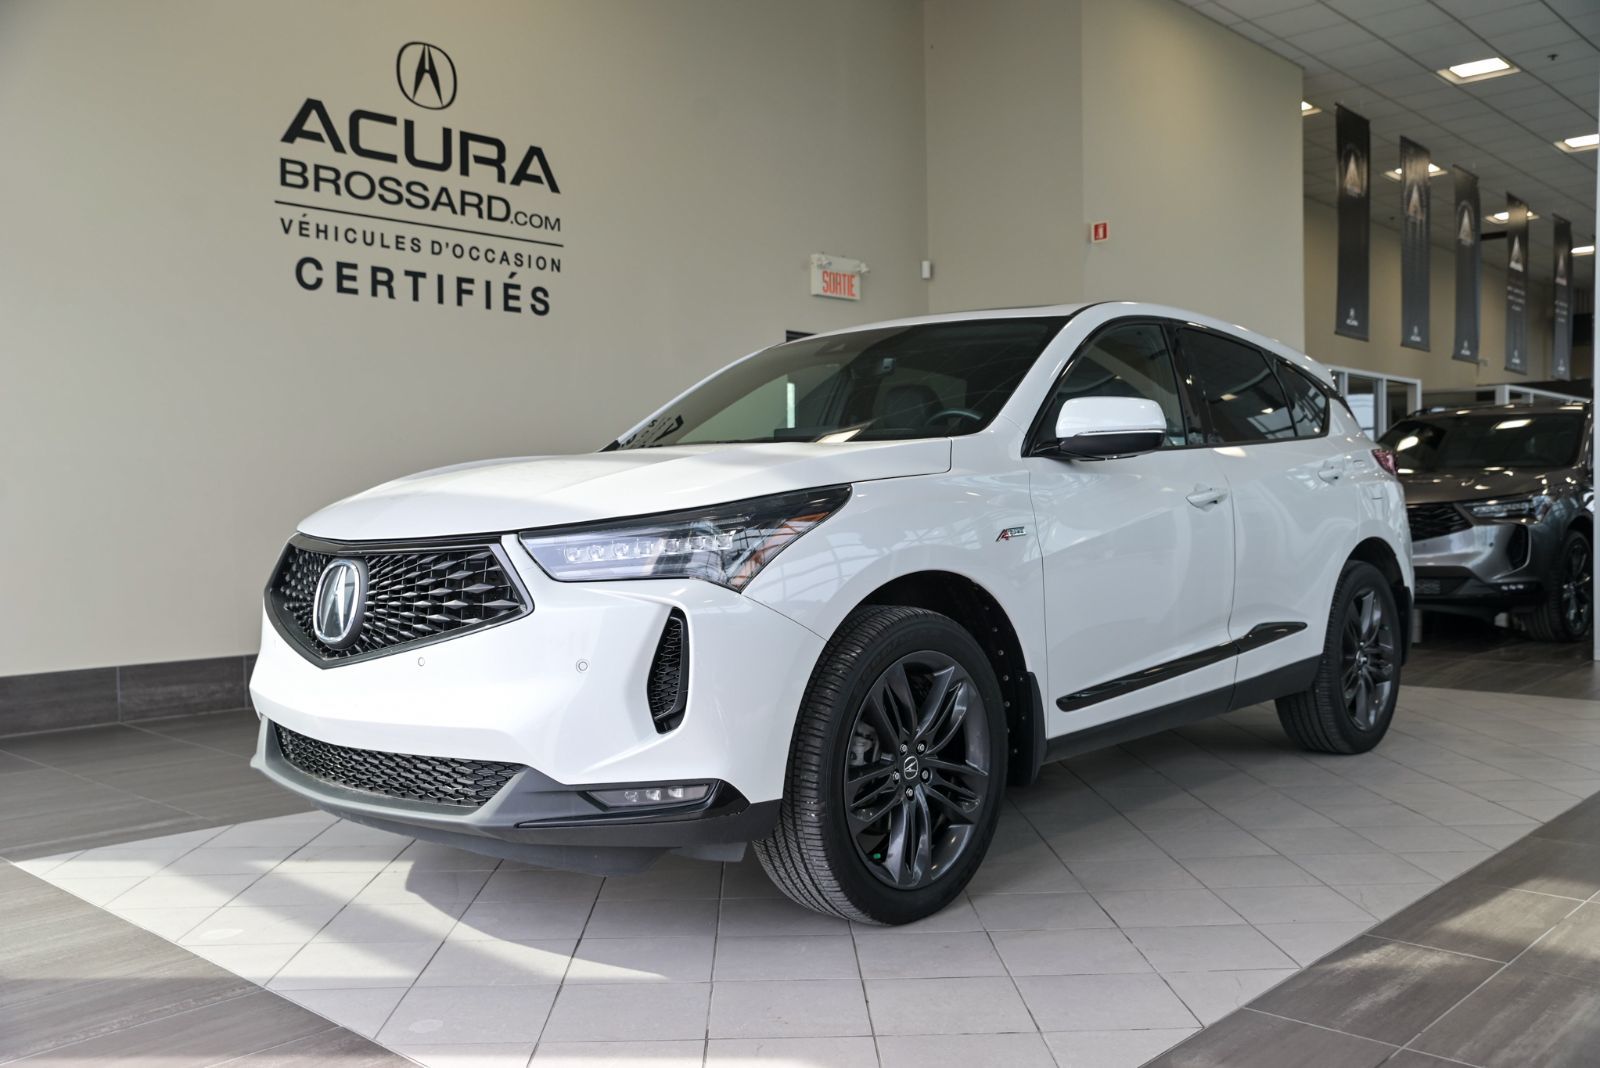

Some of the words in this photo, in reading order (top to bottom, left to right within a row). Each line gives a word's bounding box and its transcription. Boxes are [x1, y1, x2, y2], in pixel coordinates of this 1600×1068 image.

[279, 97, 561, 195] ACURA
[279, 157, 561, 232] BROSSARD.COM
[279, 213, 422, 254] VÉHICULES
[430, 239, 561, 273] D'OCCASION
[295, 256, 550, 317] CERTIFIÉS
[822, 270, 856, 297] SORTIE
